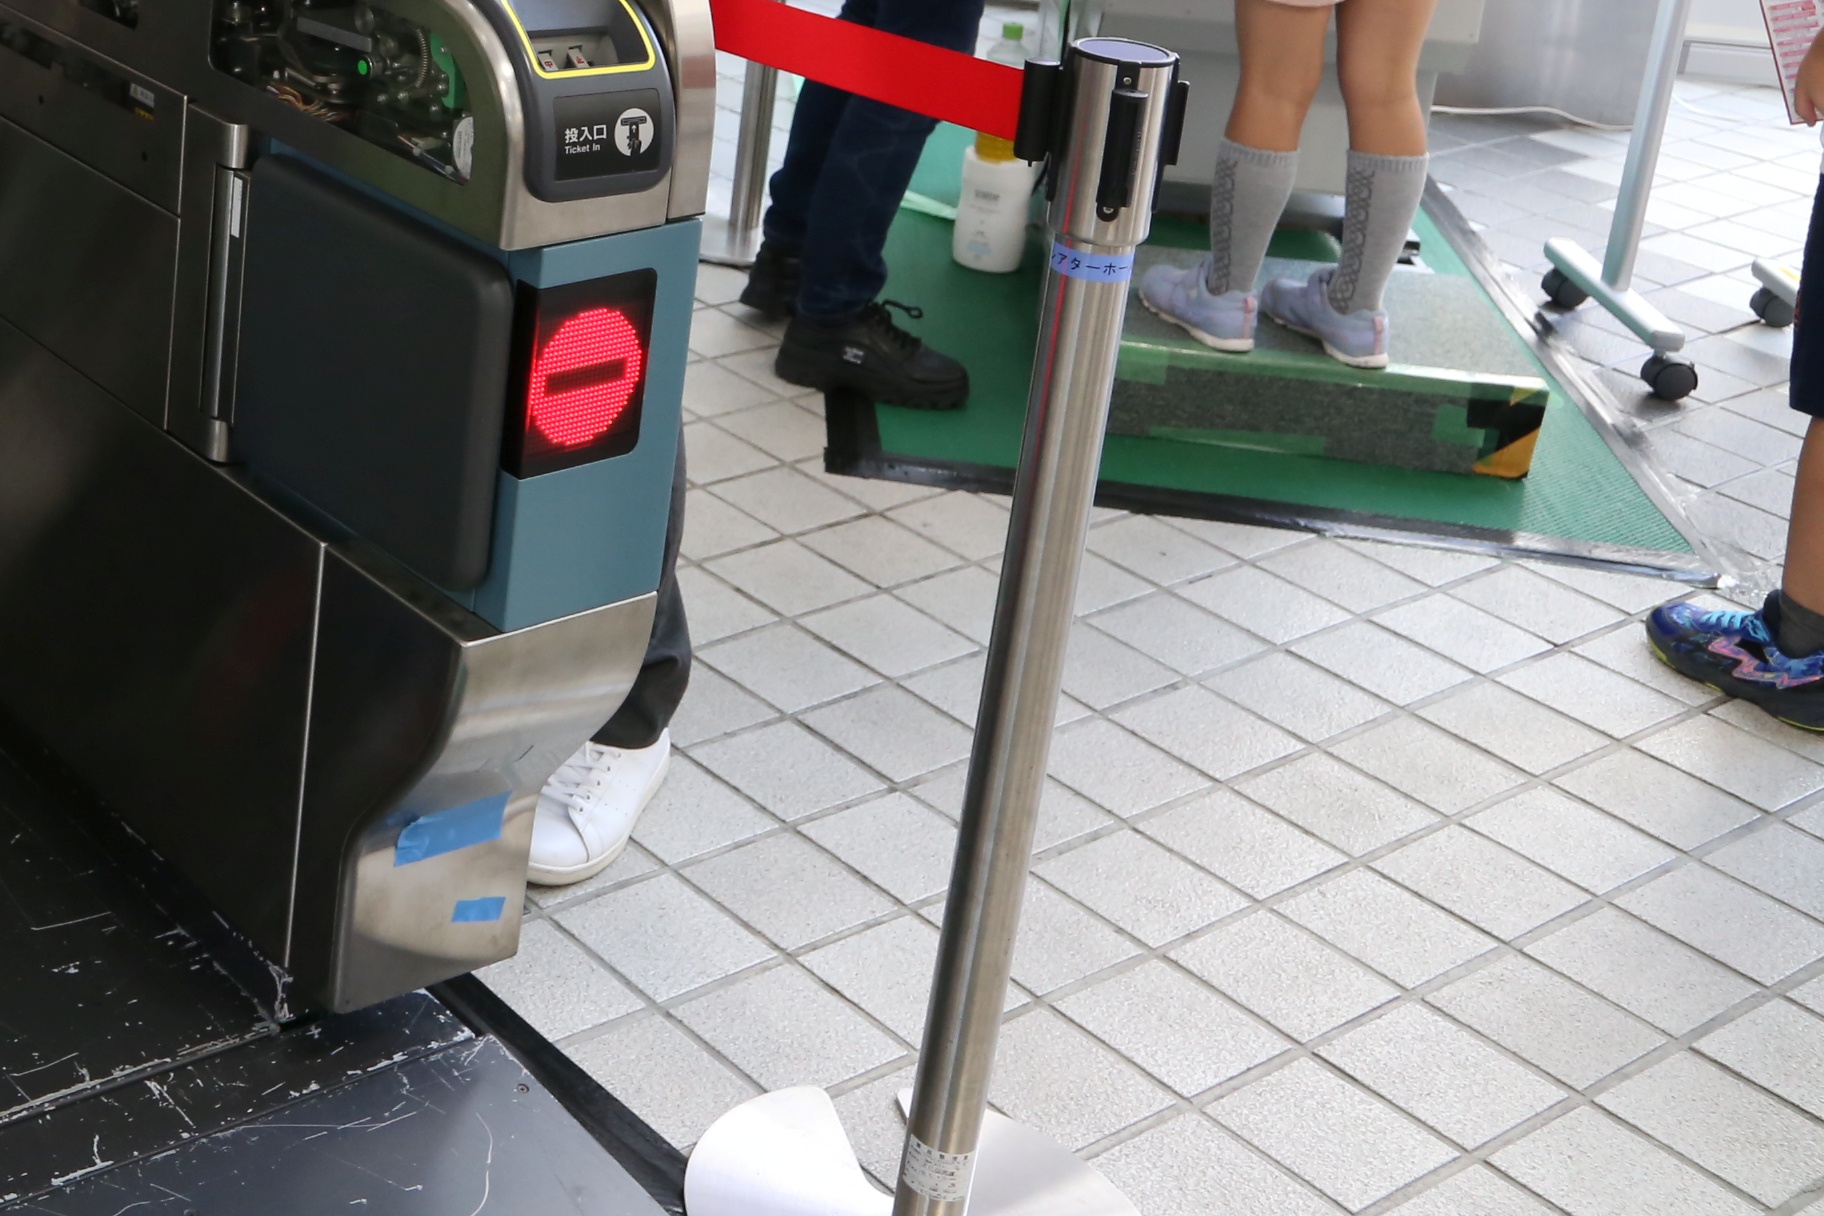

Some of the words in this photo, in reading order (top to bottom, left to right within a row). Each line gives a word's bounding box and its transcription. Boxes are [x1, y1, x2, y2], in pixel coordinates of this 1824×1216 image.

[564, 124, 607, 144] 投入口
[564, 144, 590, 155] Ticket
[592, 143, 601, 152] In
